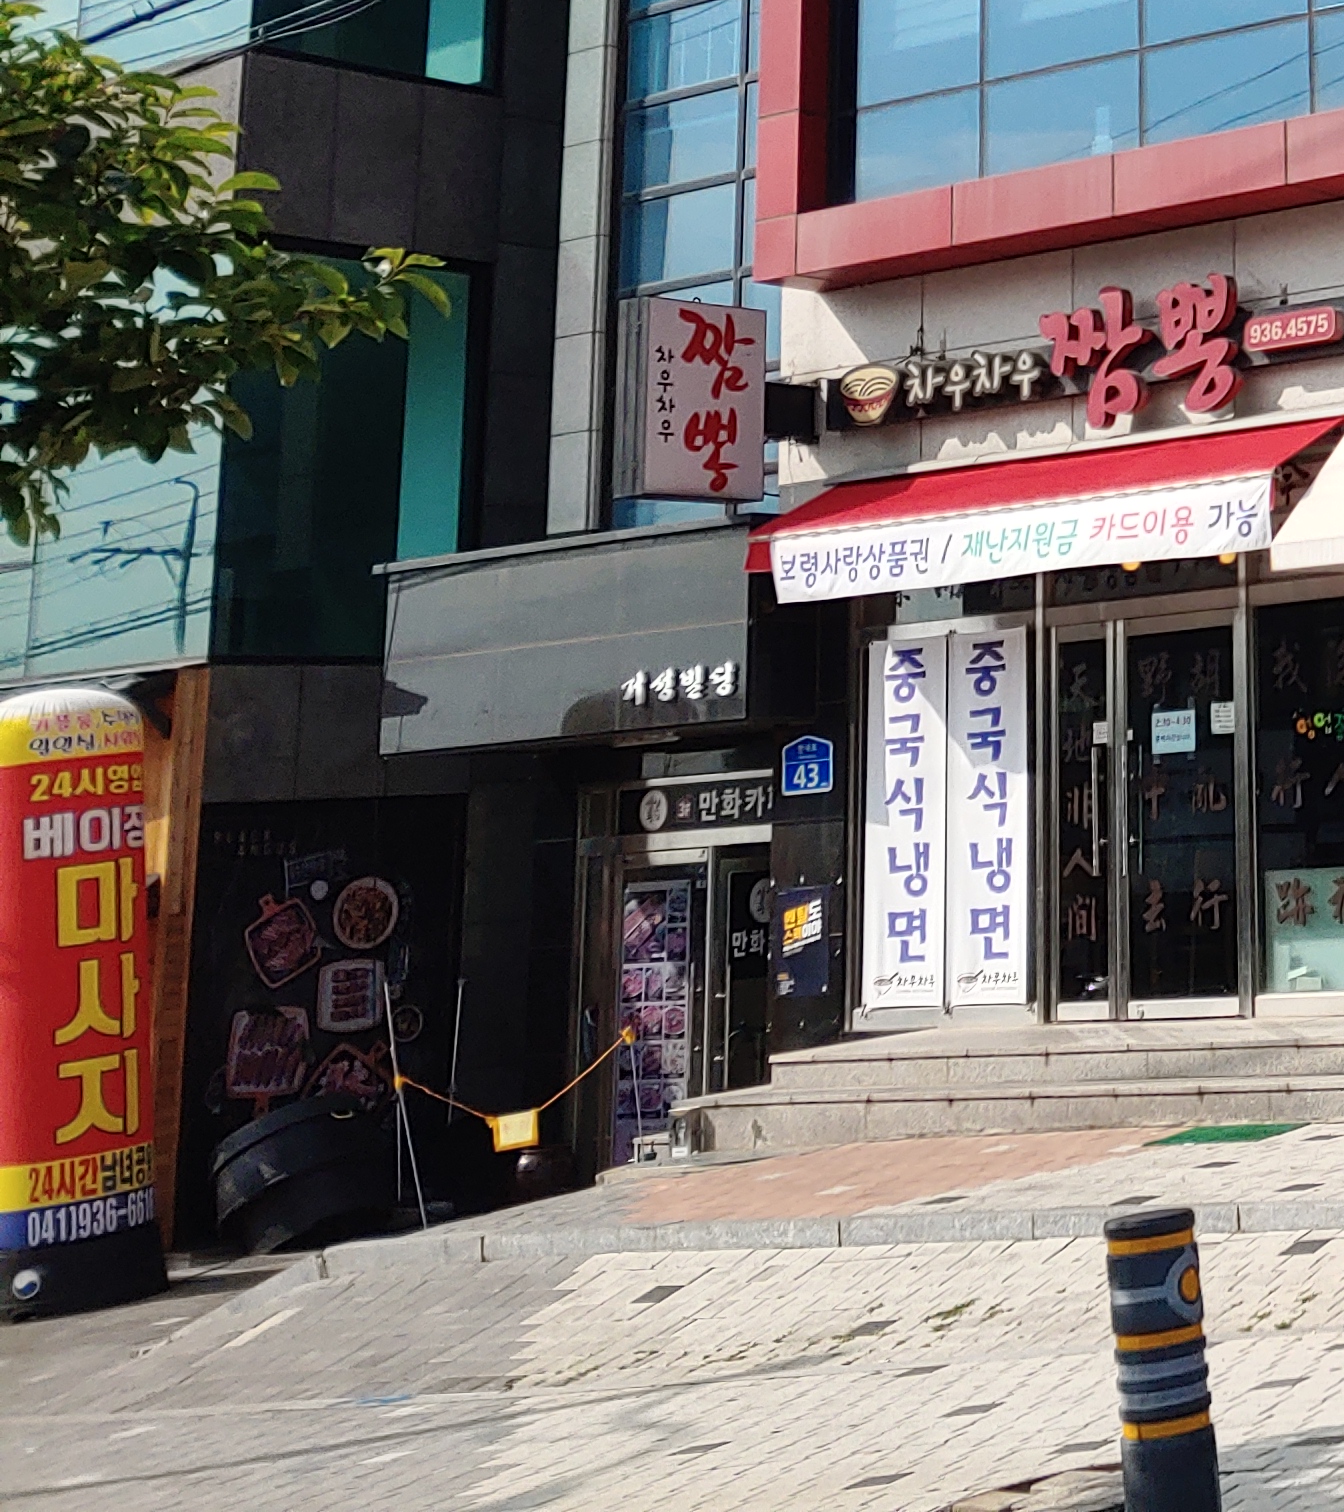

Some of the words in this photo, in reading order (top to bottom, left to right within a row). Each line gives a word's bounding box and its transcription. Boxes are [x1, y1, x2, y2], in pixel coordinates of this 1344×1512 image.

[655, 346, 676, 442] 차우차우
[677, 306, 755, 491] 짬뽕
[904, 350, 1043, 411] 차우차우
[1038, 272, 1247, 431] 짬뽕
[1248, 312, 1330, 347] 936.4575
[778, 532, 930, 586] 보령사랑상품권
[961, 522, 1080, 561] 재난지원금
[1088, 504, 1195, 546] 카드이용
[1206, 499, 1259, 537] 가능
[793, 763, 820, 789] 43
[884, 647, 930, 964] 중국식냉면
[964, 640, 1014, 961] 중국식냉면
[54, 855, 140, 1146] 마사지
